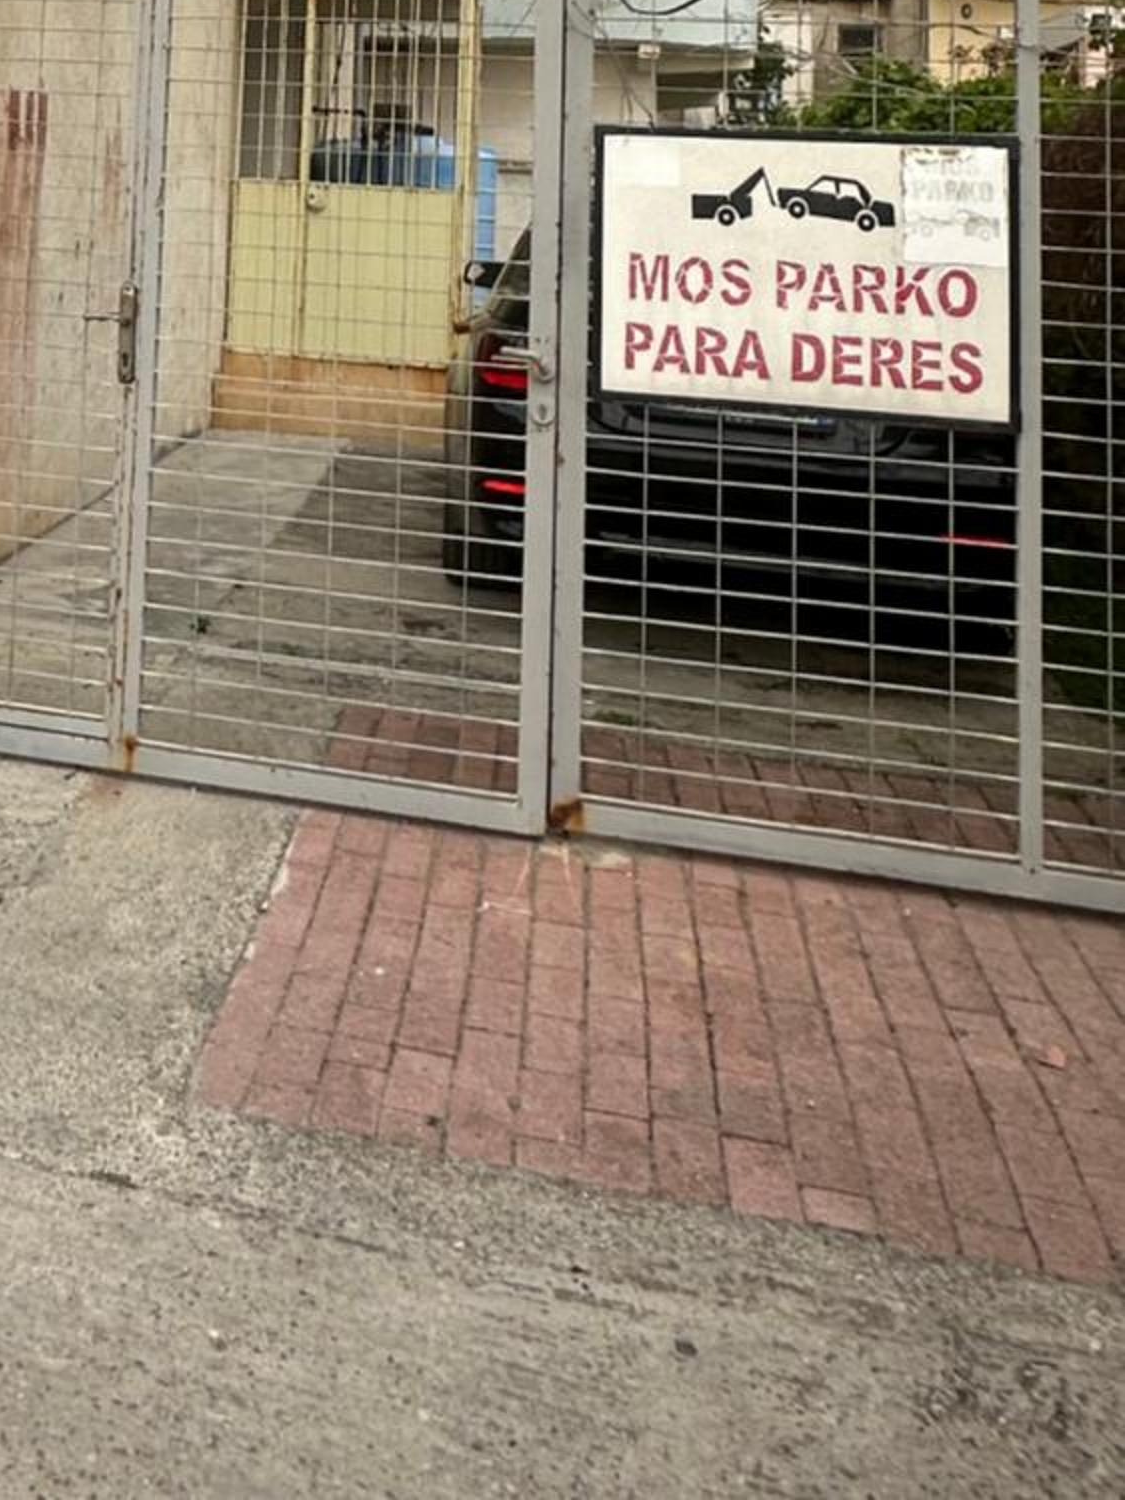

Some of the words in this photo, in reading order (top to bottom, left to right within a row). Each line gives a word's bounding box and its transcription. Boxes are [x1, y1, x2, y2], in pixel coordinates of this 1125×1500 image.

[627, 251, 753, 307] MOS
[775, 258, 979, 319] PARKO
[623, 321, 771, 382] PARA
[790, 332, 985, 395] DERES
